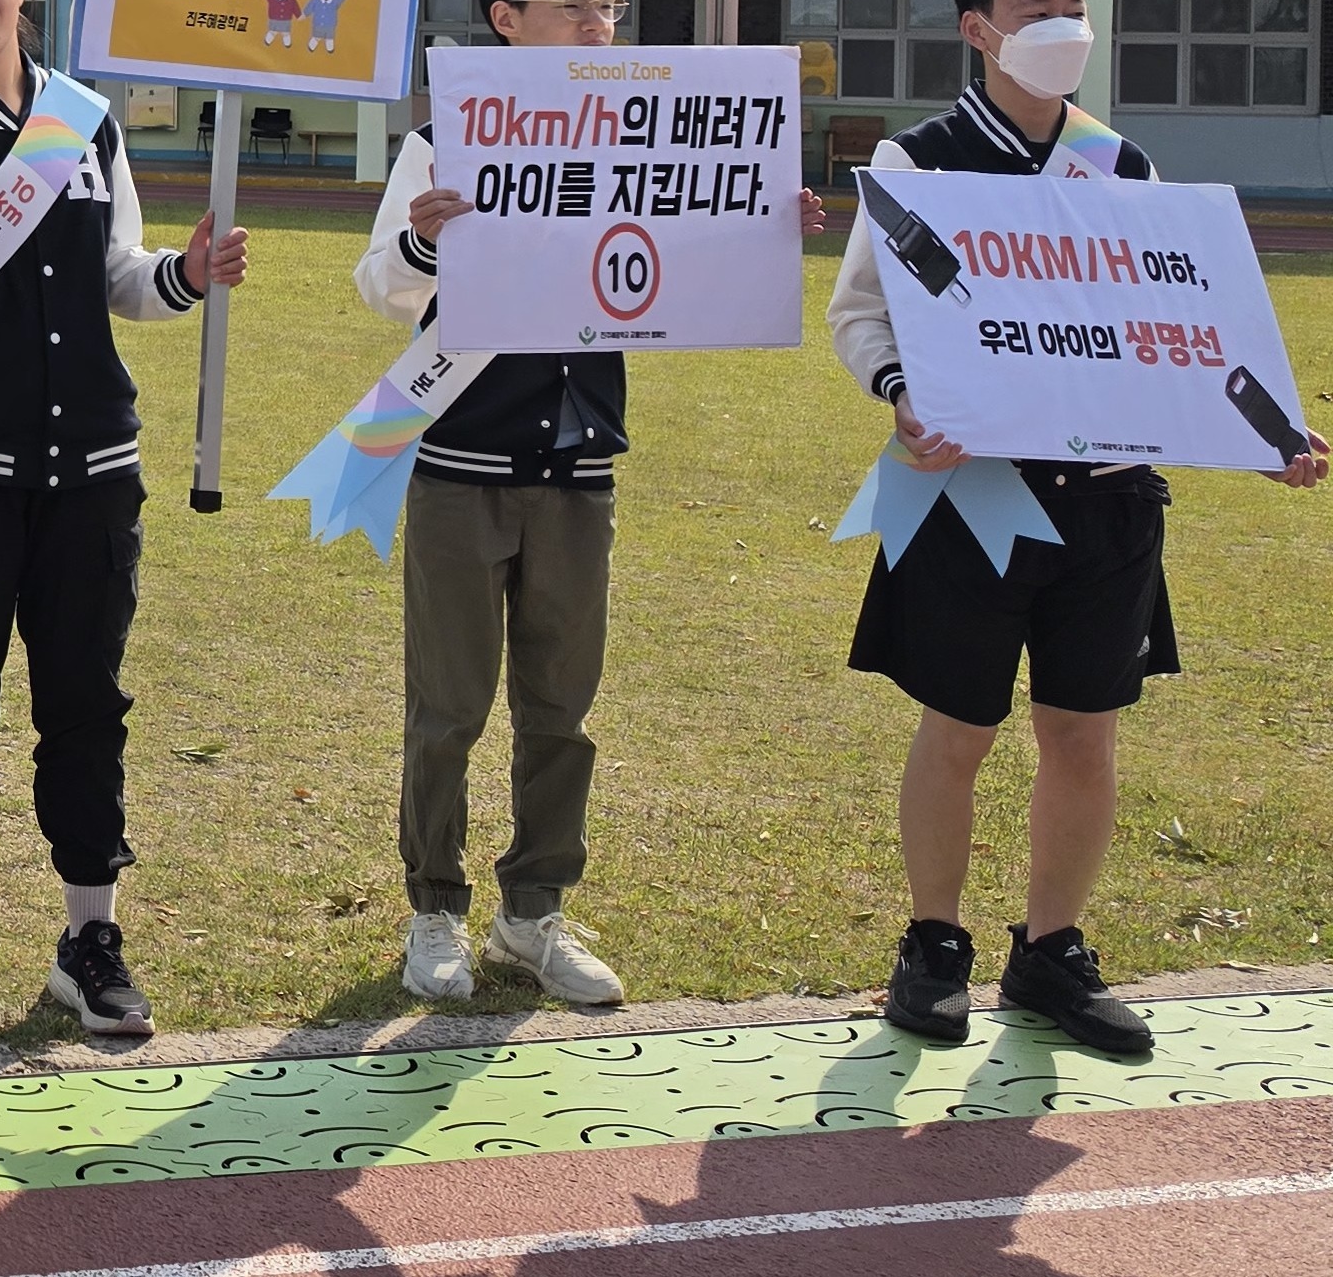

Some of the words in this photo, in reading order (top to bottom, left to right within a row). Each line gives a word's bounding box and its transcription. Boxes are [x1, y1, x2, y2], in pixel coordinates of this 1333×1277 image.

[186, 11, 249, 32] 진주혜광학교
[568, 61, 626, 81] School
[630, 62, 672, 81] Zone
[459, 93, 659, 149] 10km/h의
[670, 95, 787, 149] 배려가
[474, 161, 596, 218] 아이를
[607, 162, 770, 216] 지킵니다.
[607, 251, 648, 293] 10
[953, 229, 1141, 285] 10KM/H
[1142, 250, 1210, 291] 이하,
[979, 319, 1034, 356] 우리
[1039, 322, 1122, 360] 아이의
[1124, 319, 1226, 367] 생명선
